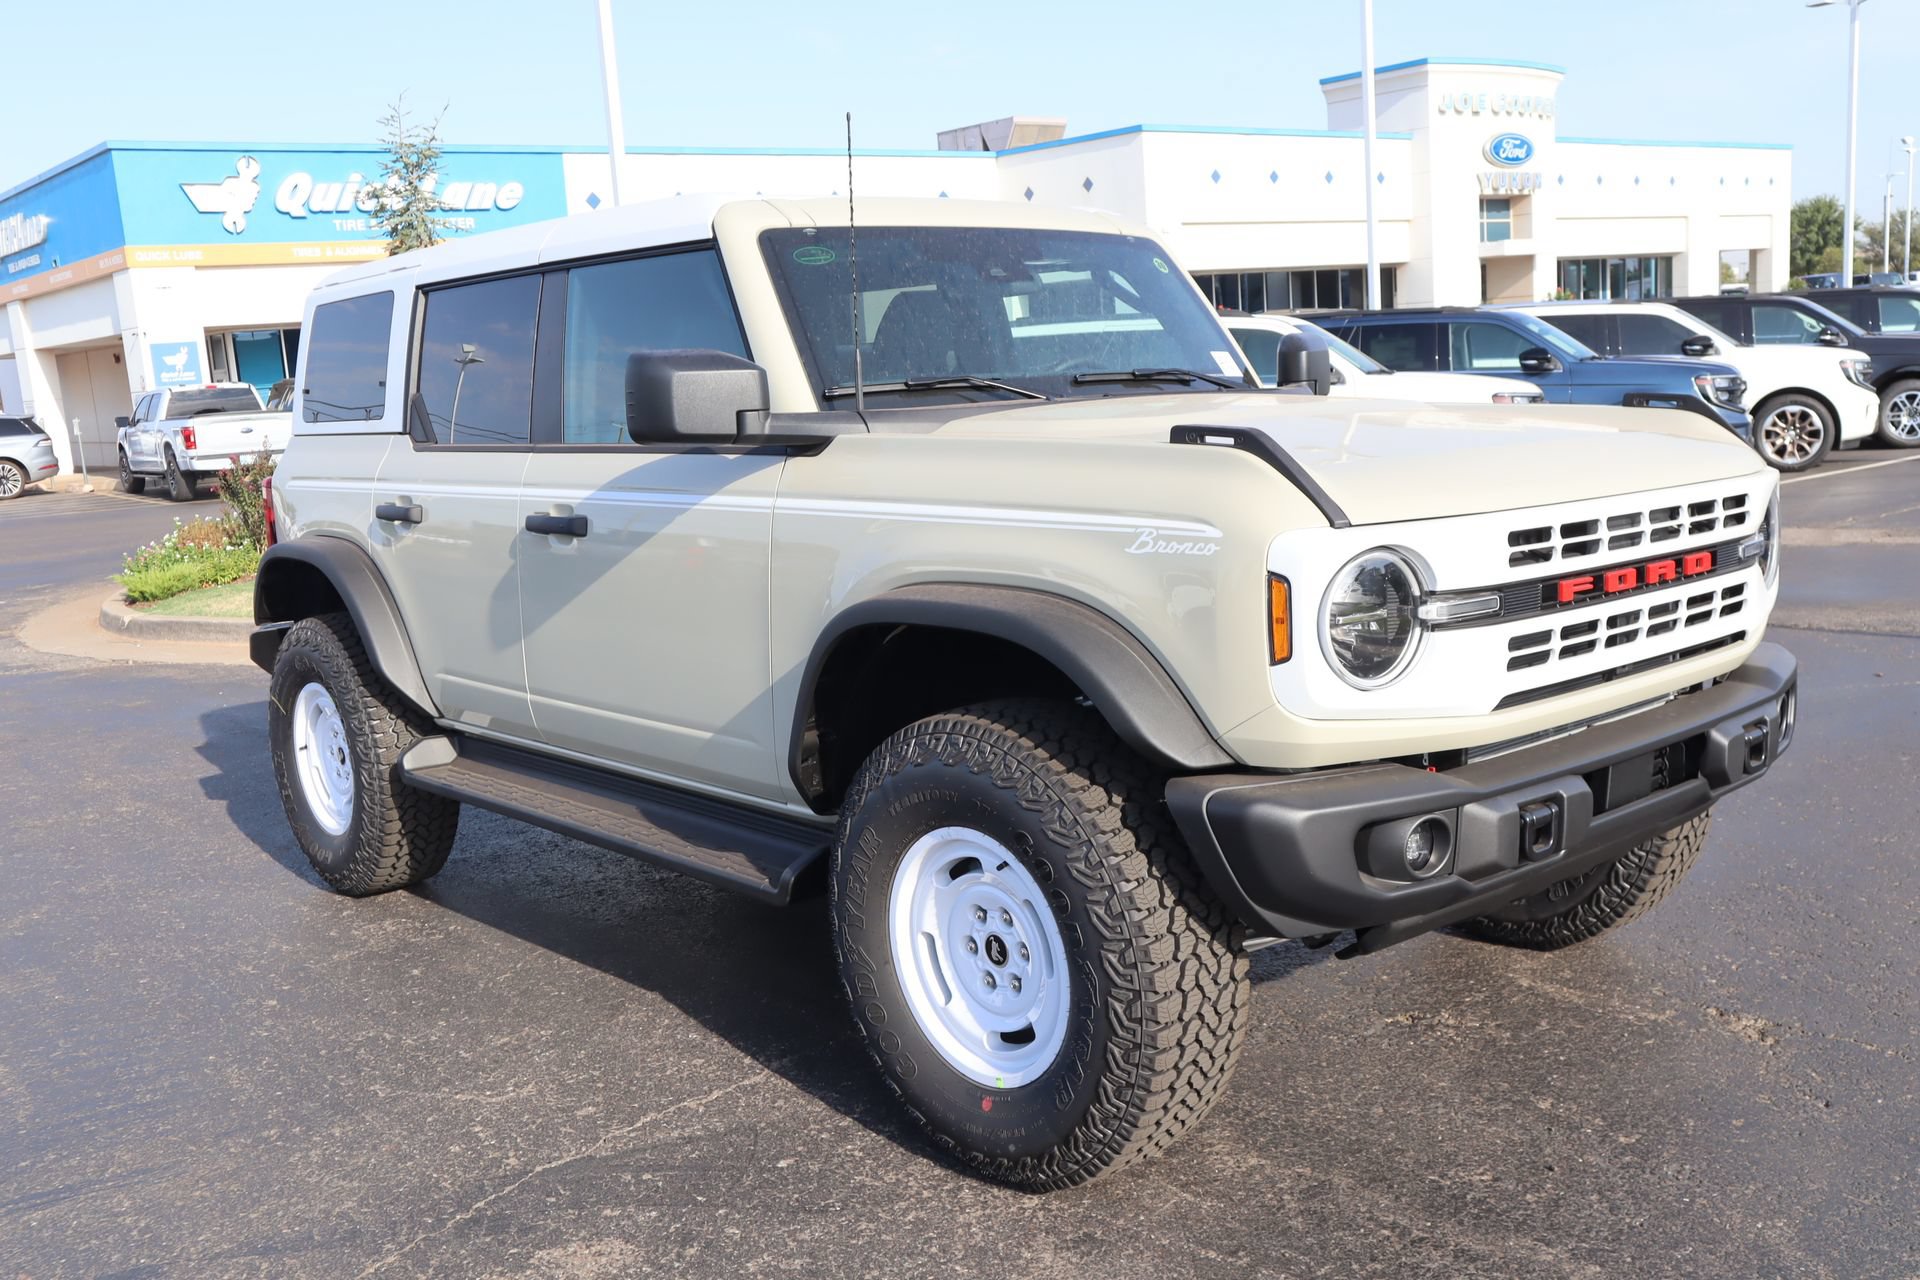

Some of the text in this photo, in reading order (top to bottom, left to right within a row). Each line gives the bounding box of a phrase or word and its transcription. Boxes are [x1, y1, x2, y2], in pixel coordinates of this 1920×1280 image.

[1492, 94, 1554, 118] COOPE
[1479, 172, 1542, 191] YUKON
[333, 219, 366, 231] TIRE
[429, 217, 475, 230] ENTER
[136, 250, 171, 262] QUICK
[1124, 527, 1221, 556] Bronco
[1558, 551, 1712, 602] FORD
[841, 824, 919, 1081] GOODYEAR
